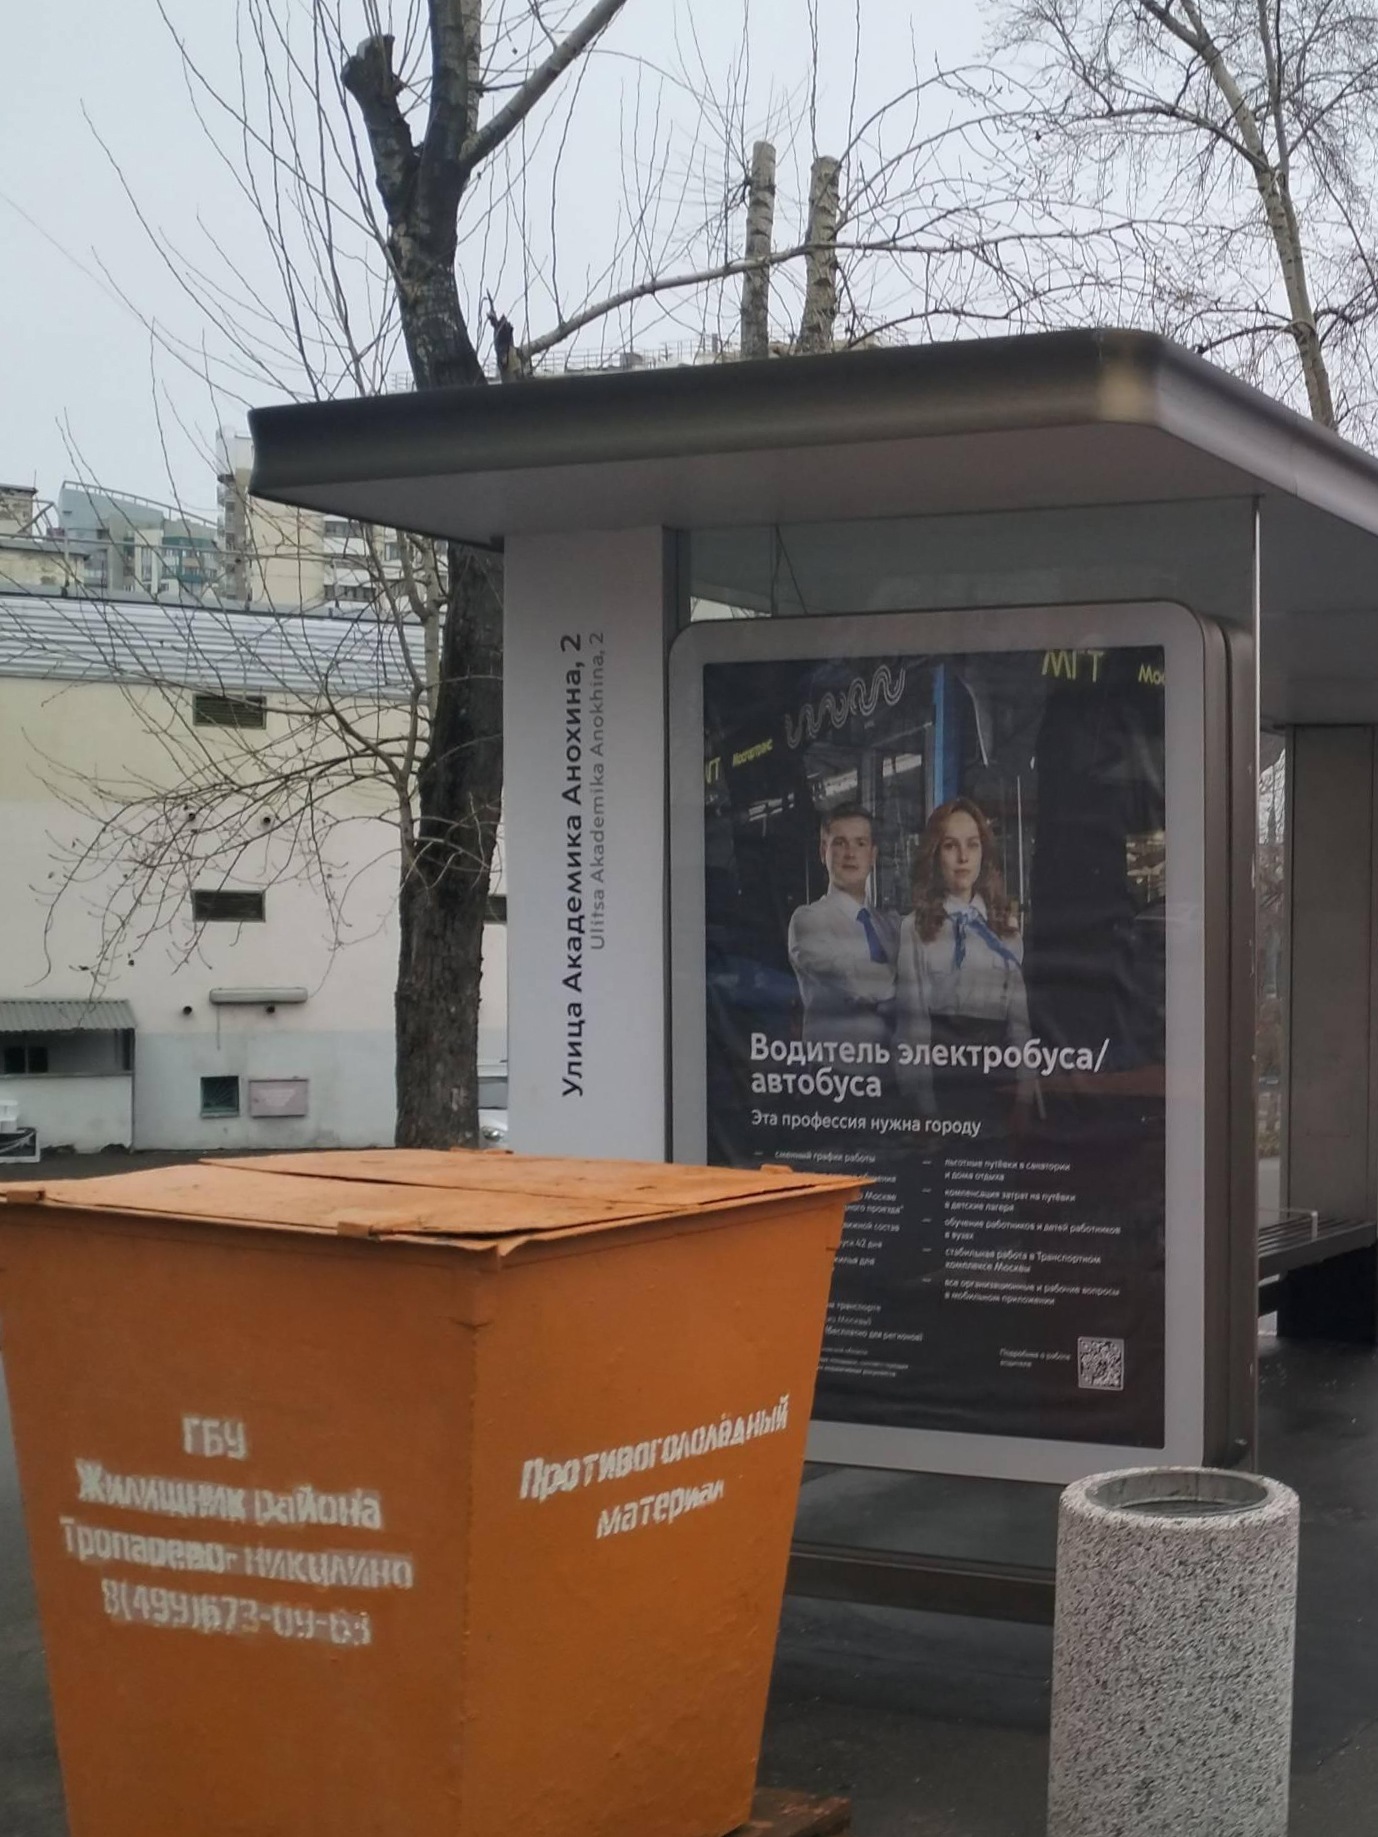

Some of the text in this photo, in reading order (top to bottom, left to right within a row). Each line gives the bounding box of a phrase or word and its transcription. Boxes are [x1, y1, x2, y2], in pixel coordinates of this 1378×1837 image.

[590, 632, 607, 950] Ulitsa Akademika Anokhina, 2
[561, 634, 585, 1097] Улица Академика Анохина, 2
[750, 1032, 1110, 1076] Водитель электробуса/
[751, 1066, 882, 1103] автобуса
[751, 1110, 981, 1137] Эта профессия нужна городу
[182, 1416, 248, 1459] ГБУ
